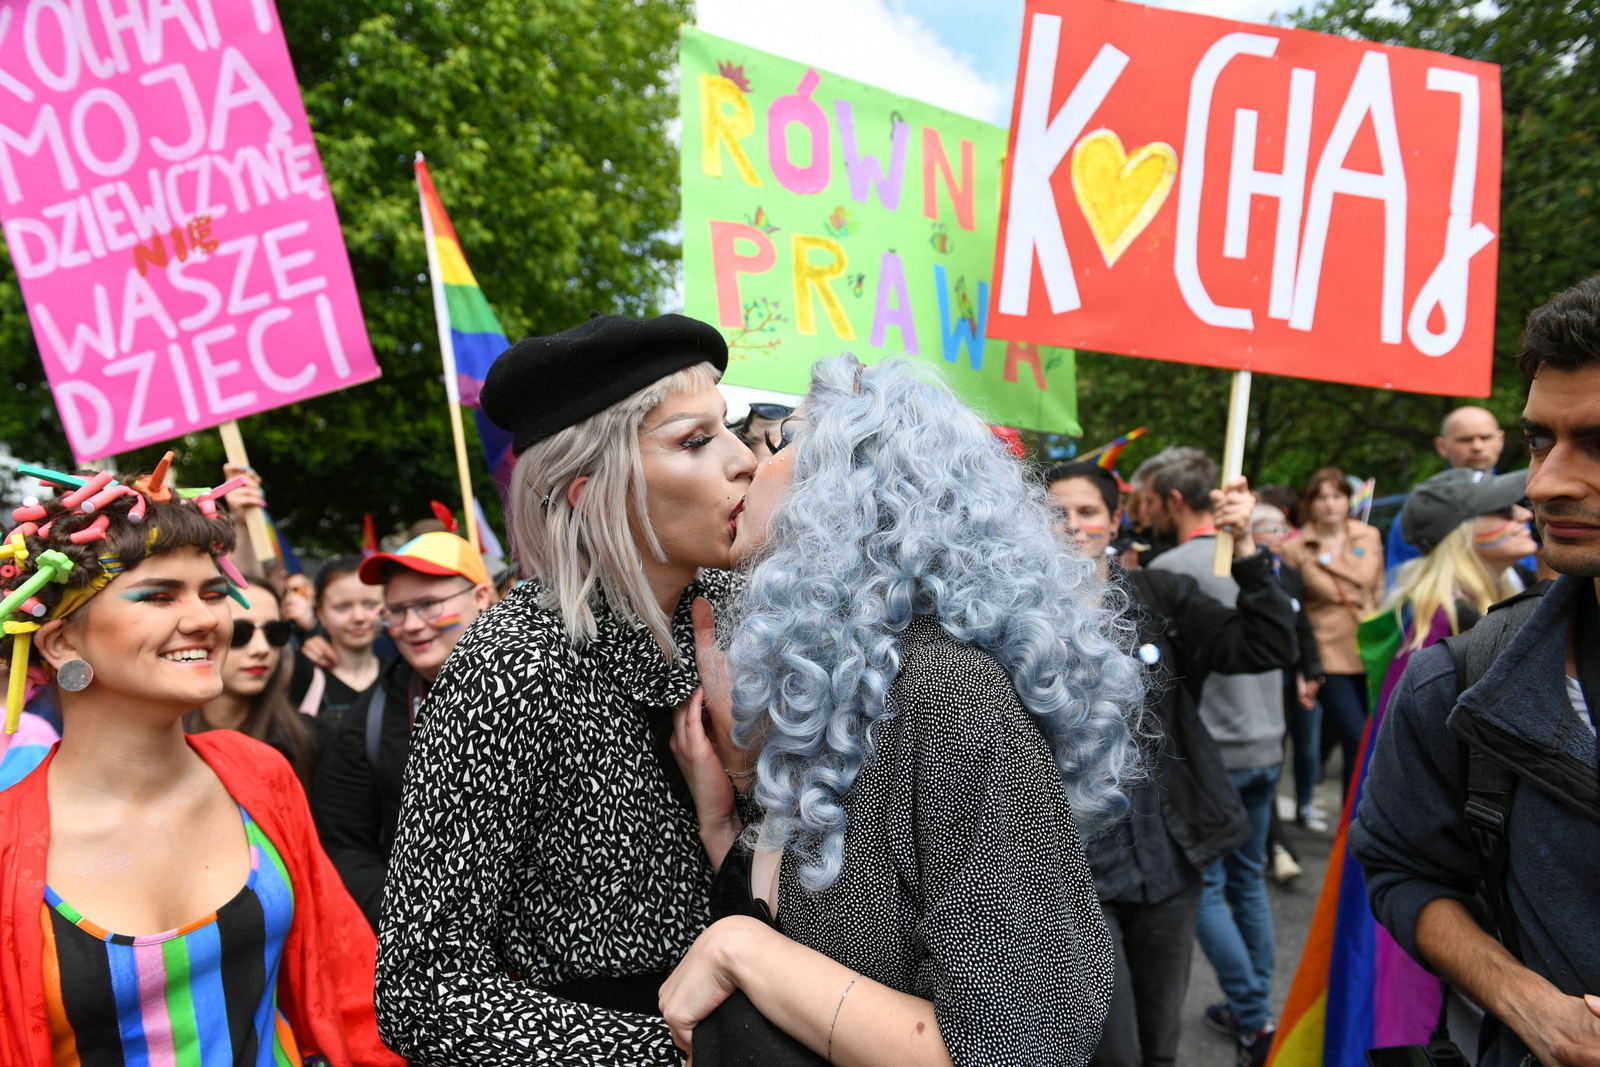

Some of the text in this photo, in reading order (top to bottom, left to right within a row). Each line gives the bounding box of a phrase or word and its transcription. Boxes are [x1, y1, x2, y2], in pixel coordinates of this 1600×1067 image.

[698, 66, 1008, 236] RÓWN
[33, 220, 328, 374] WASZE
[132, 215, 220, 277] NIE
[55, 292, 351, 457] DZIECI
